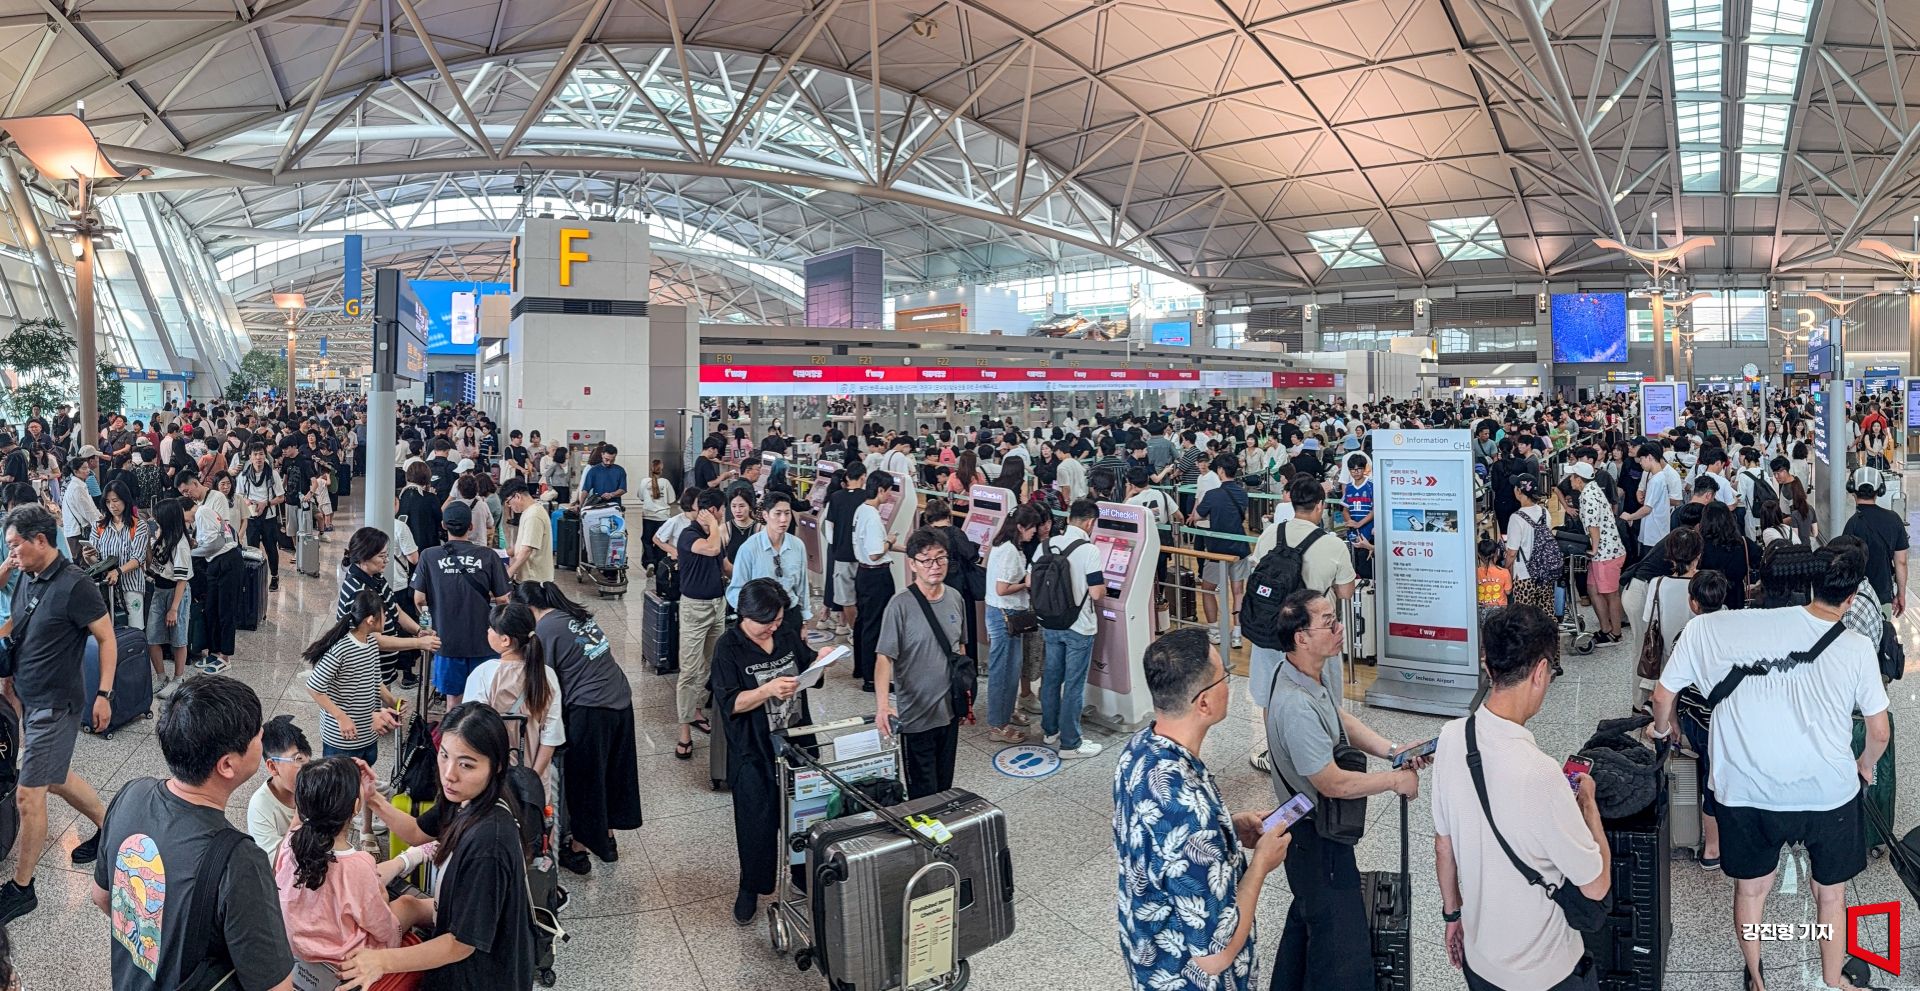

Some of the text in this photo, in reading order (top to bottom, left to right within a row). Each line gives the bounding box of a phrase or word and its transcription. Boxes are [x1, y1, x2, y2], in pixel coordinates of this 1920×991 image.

[560, 228, 590, 286] F
[346, 299, 359, 316] G
[1797, 309, 1816, 340] 3
[716, 354, 733, 363] F19
[811, 356, 826, 364] F20
[937, 358, 950, 366] F22
[1390, 476, 1405, 485] F19
[1411, 477, 1422, 485] 34
[1111, 509, 1139, 520] Check-in
[1407, 548, 1416, 556] G1
[1423, 549, 1433, 557] 10
[912, 902, 937, 914] Prohibited
[297, 970, 317, 987] Airport
